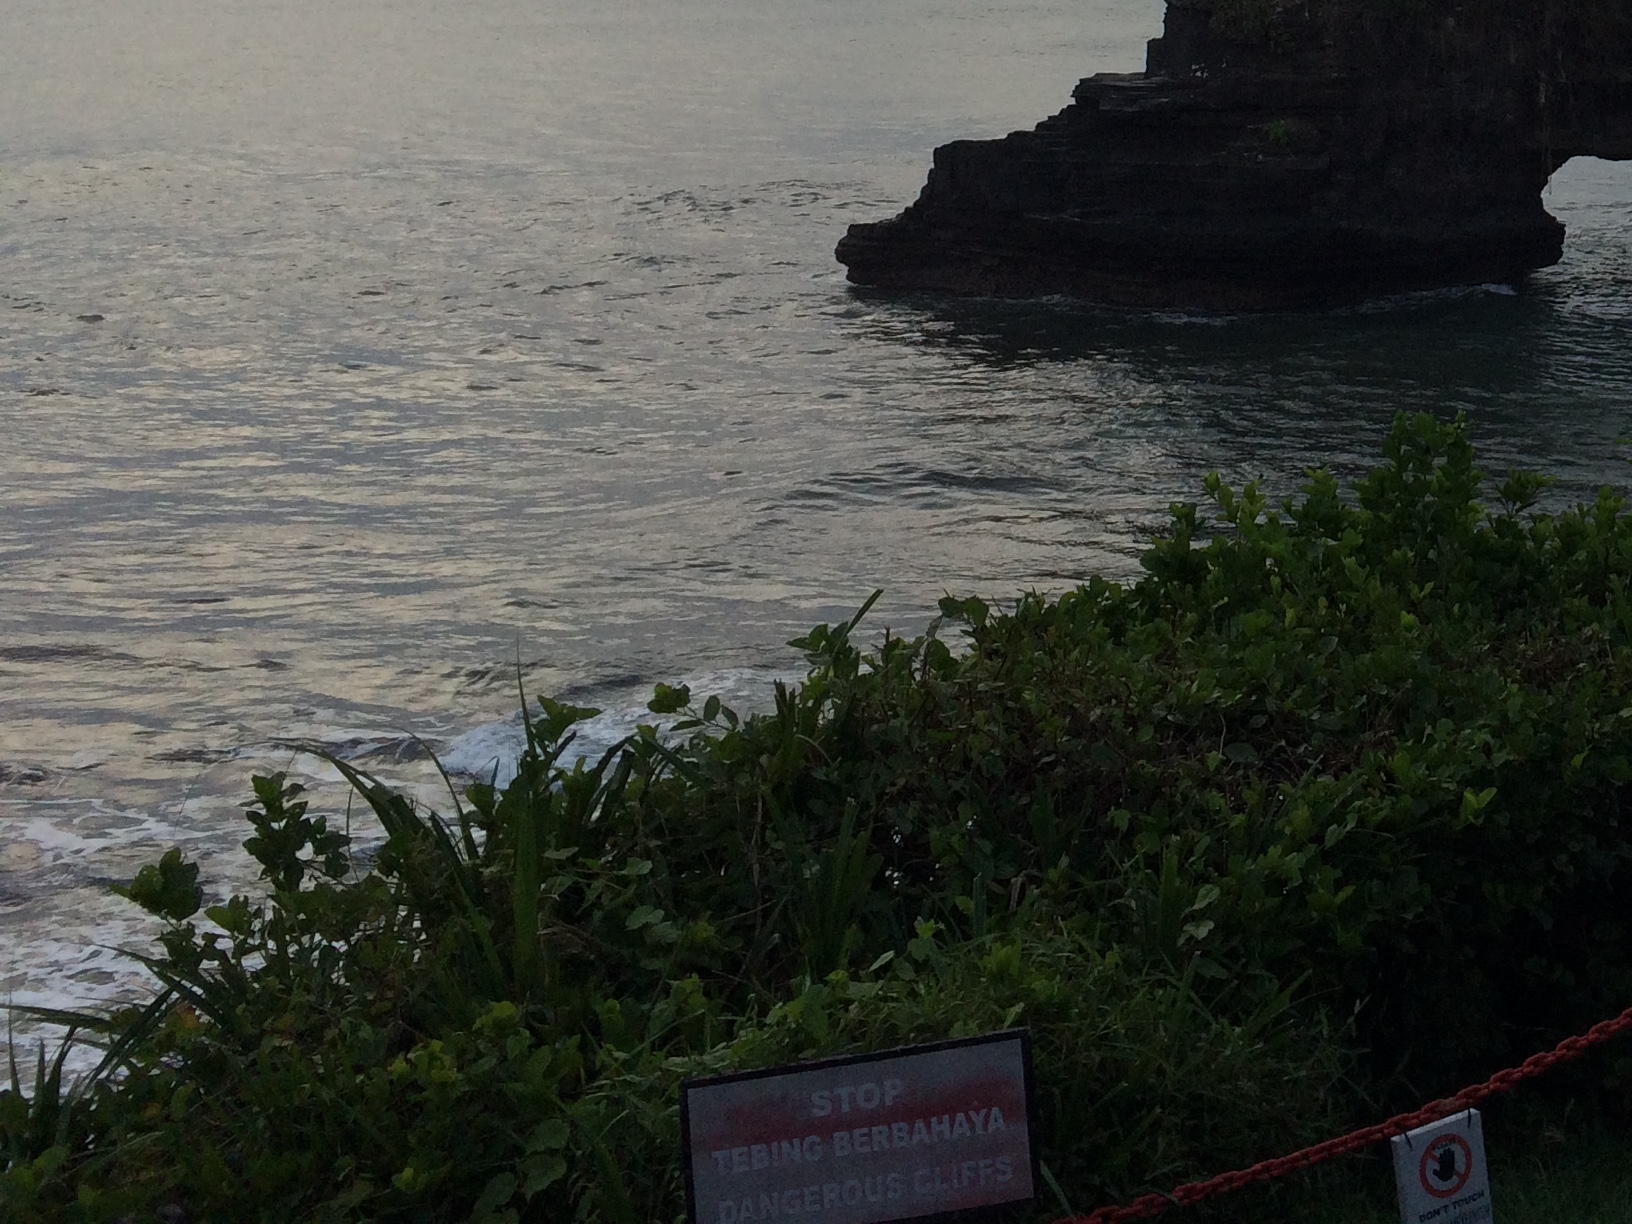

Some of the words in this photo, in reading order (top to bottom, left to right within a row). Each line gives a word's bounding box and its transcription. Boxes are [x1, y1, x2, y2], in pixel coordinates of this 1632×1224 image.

[811, 1080, 901, 1118] STOP
[711, 1136, 824, 1174] TEBING
[833, 1107, 1006, 1157] BERBAHAYA
[718, 1174, 901, 1224] DANGEROUS
[914, 1157, 1014, 1194] CLIFFS
[1452, 1190, 1484, 1209] TOUCH
